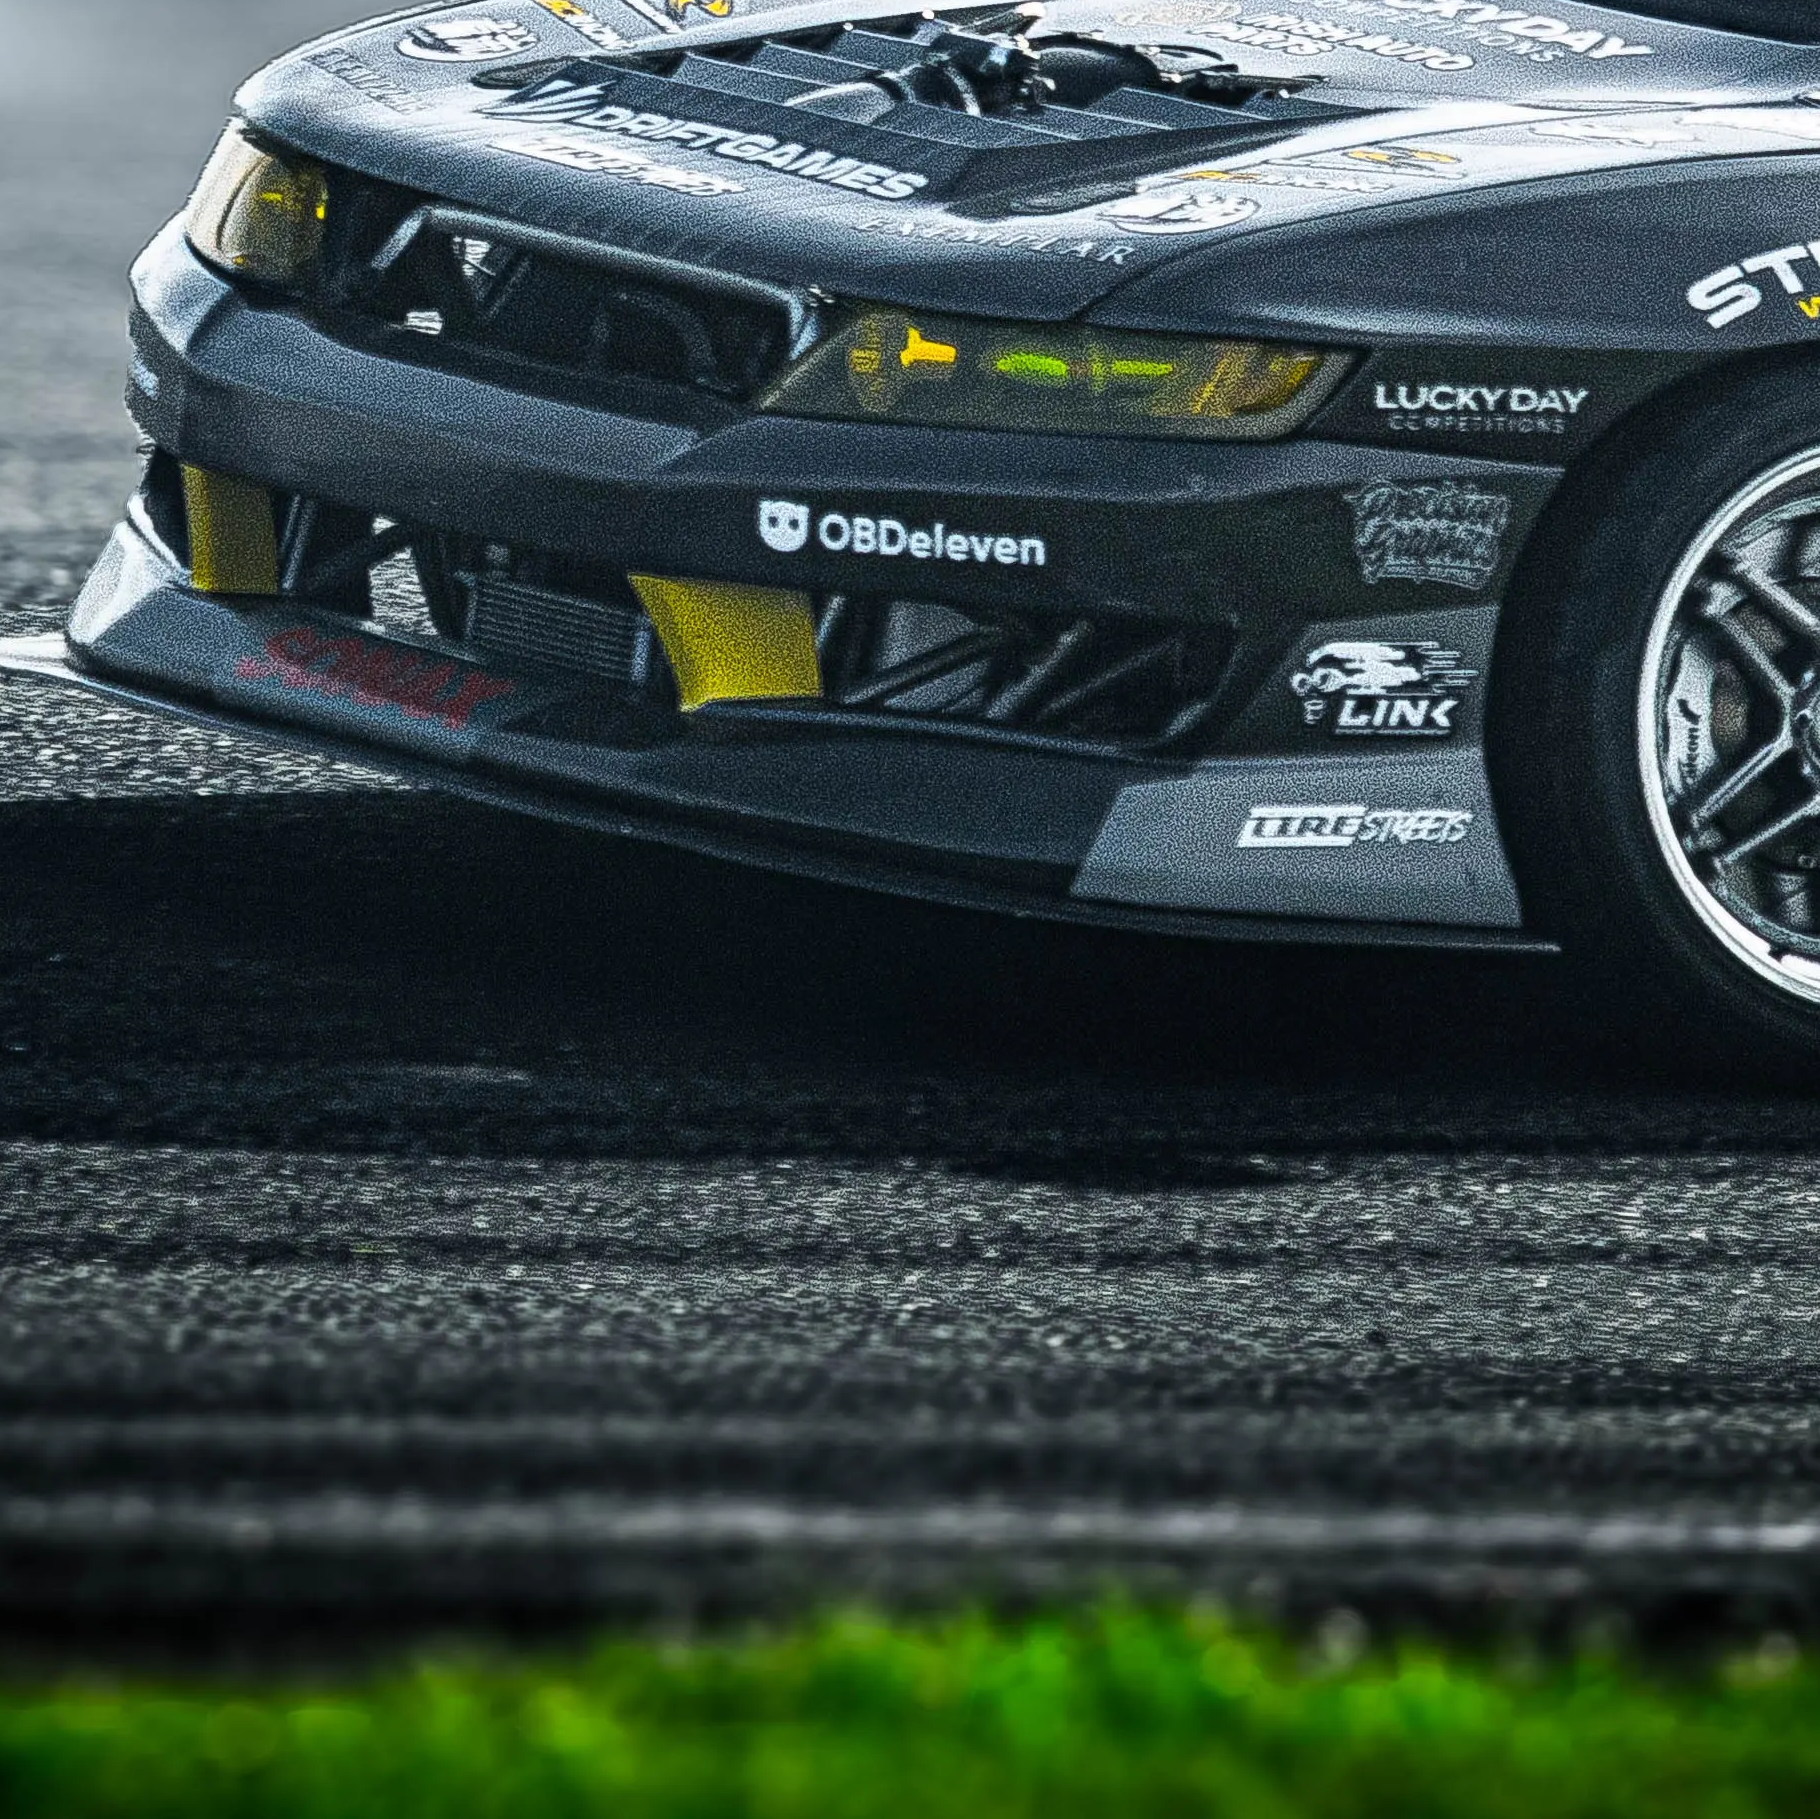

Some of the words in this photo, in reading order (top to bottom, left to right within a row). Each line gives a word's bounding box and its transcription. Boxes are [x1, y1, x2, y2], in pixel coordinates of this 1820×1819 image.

[1186, 23, 1335, 58] PARTS
[1237, 14, 1353, 50] IRISH
[1346, 32, 1475, 72] AUTO
[1510, 14, 1655, 60] DAY
[1376, 384, 1509, 411] LUCKY
[1509, 387, 1589, 413] DAY
[818, 513, 1046, 566] OBDeleven
[1338, 700, 1459, 727] LINK
